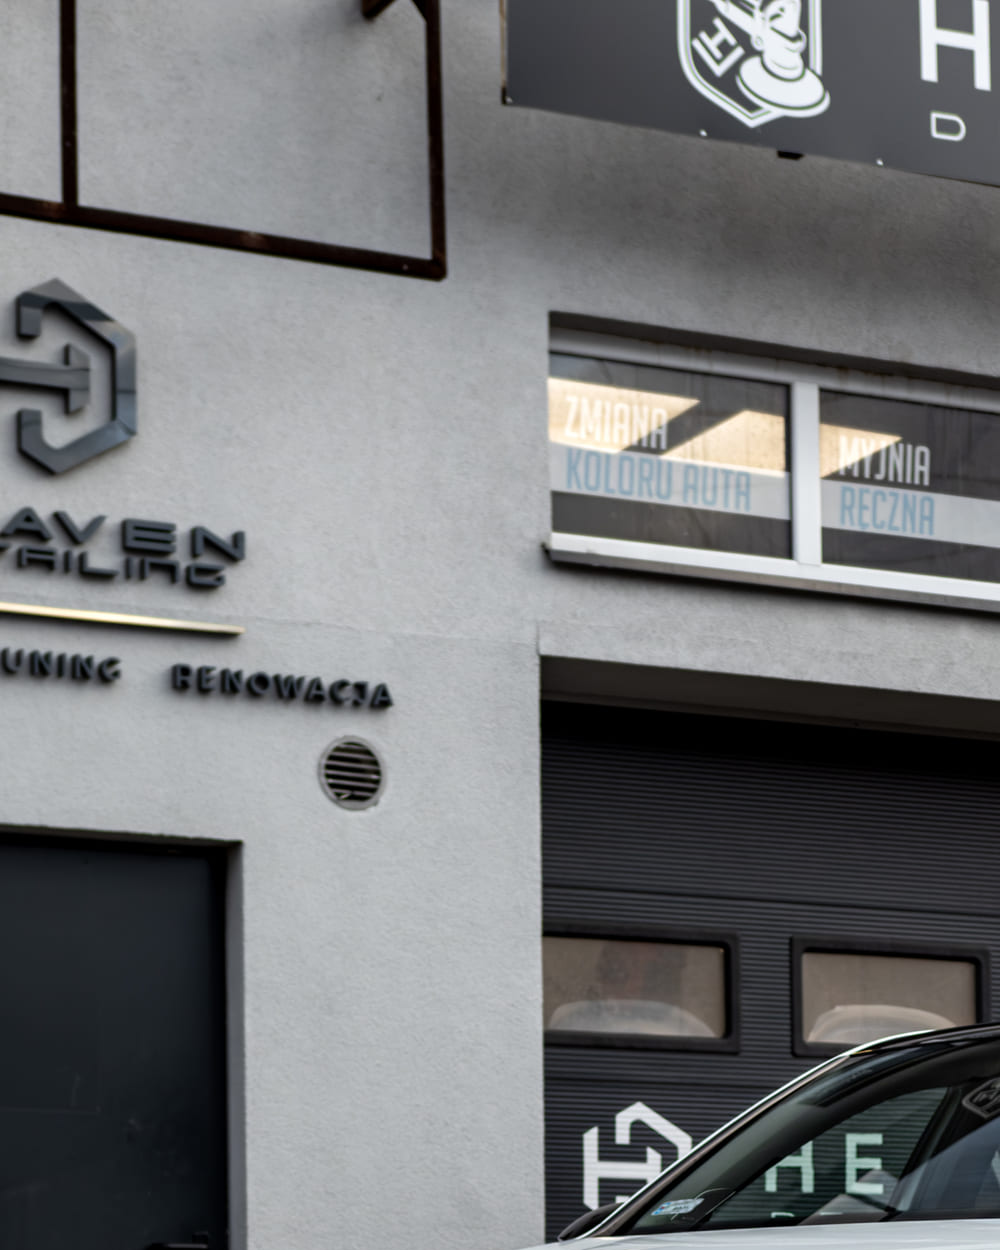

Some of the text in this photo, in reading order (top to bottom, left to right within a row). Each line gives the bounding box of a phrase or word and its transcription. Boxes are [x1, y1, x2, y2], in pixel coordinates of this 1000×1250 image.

[563, 395, 669, 450] ZMIANA
[566, 447, 752, 512] KOLORU AUTA
[838, 435, 931, 486] MYJNIA
[171, 662, 394, 709] RENOWACJA
